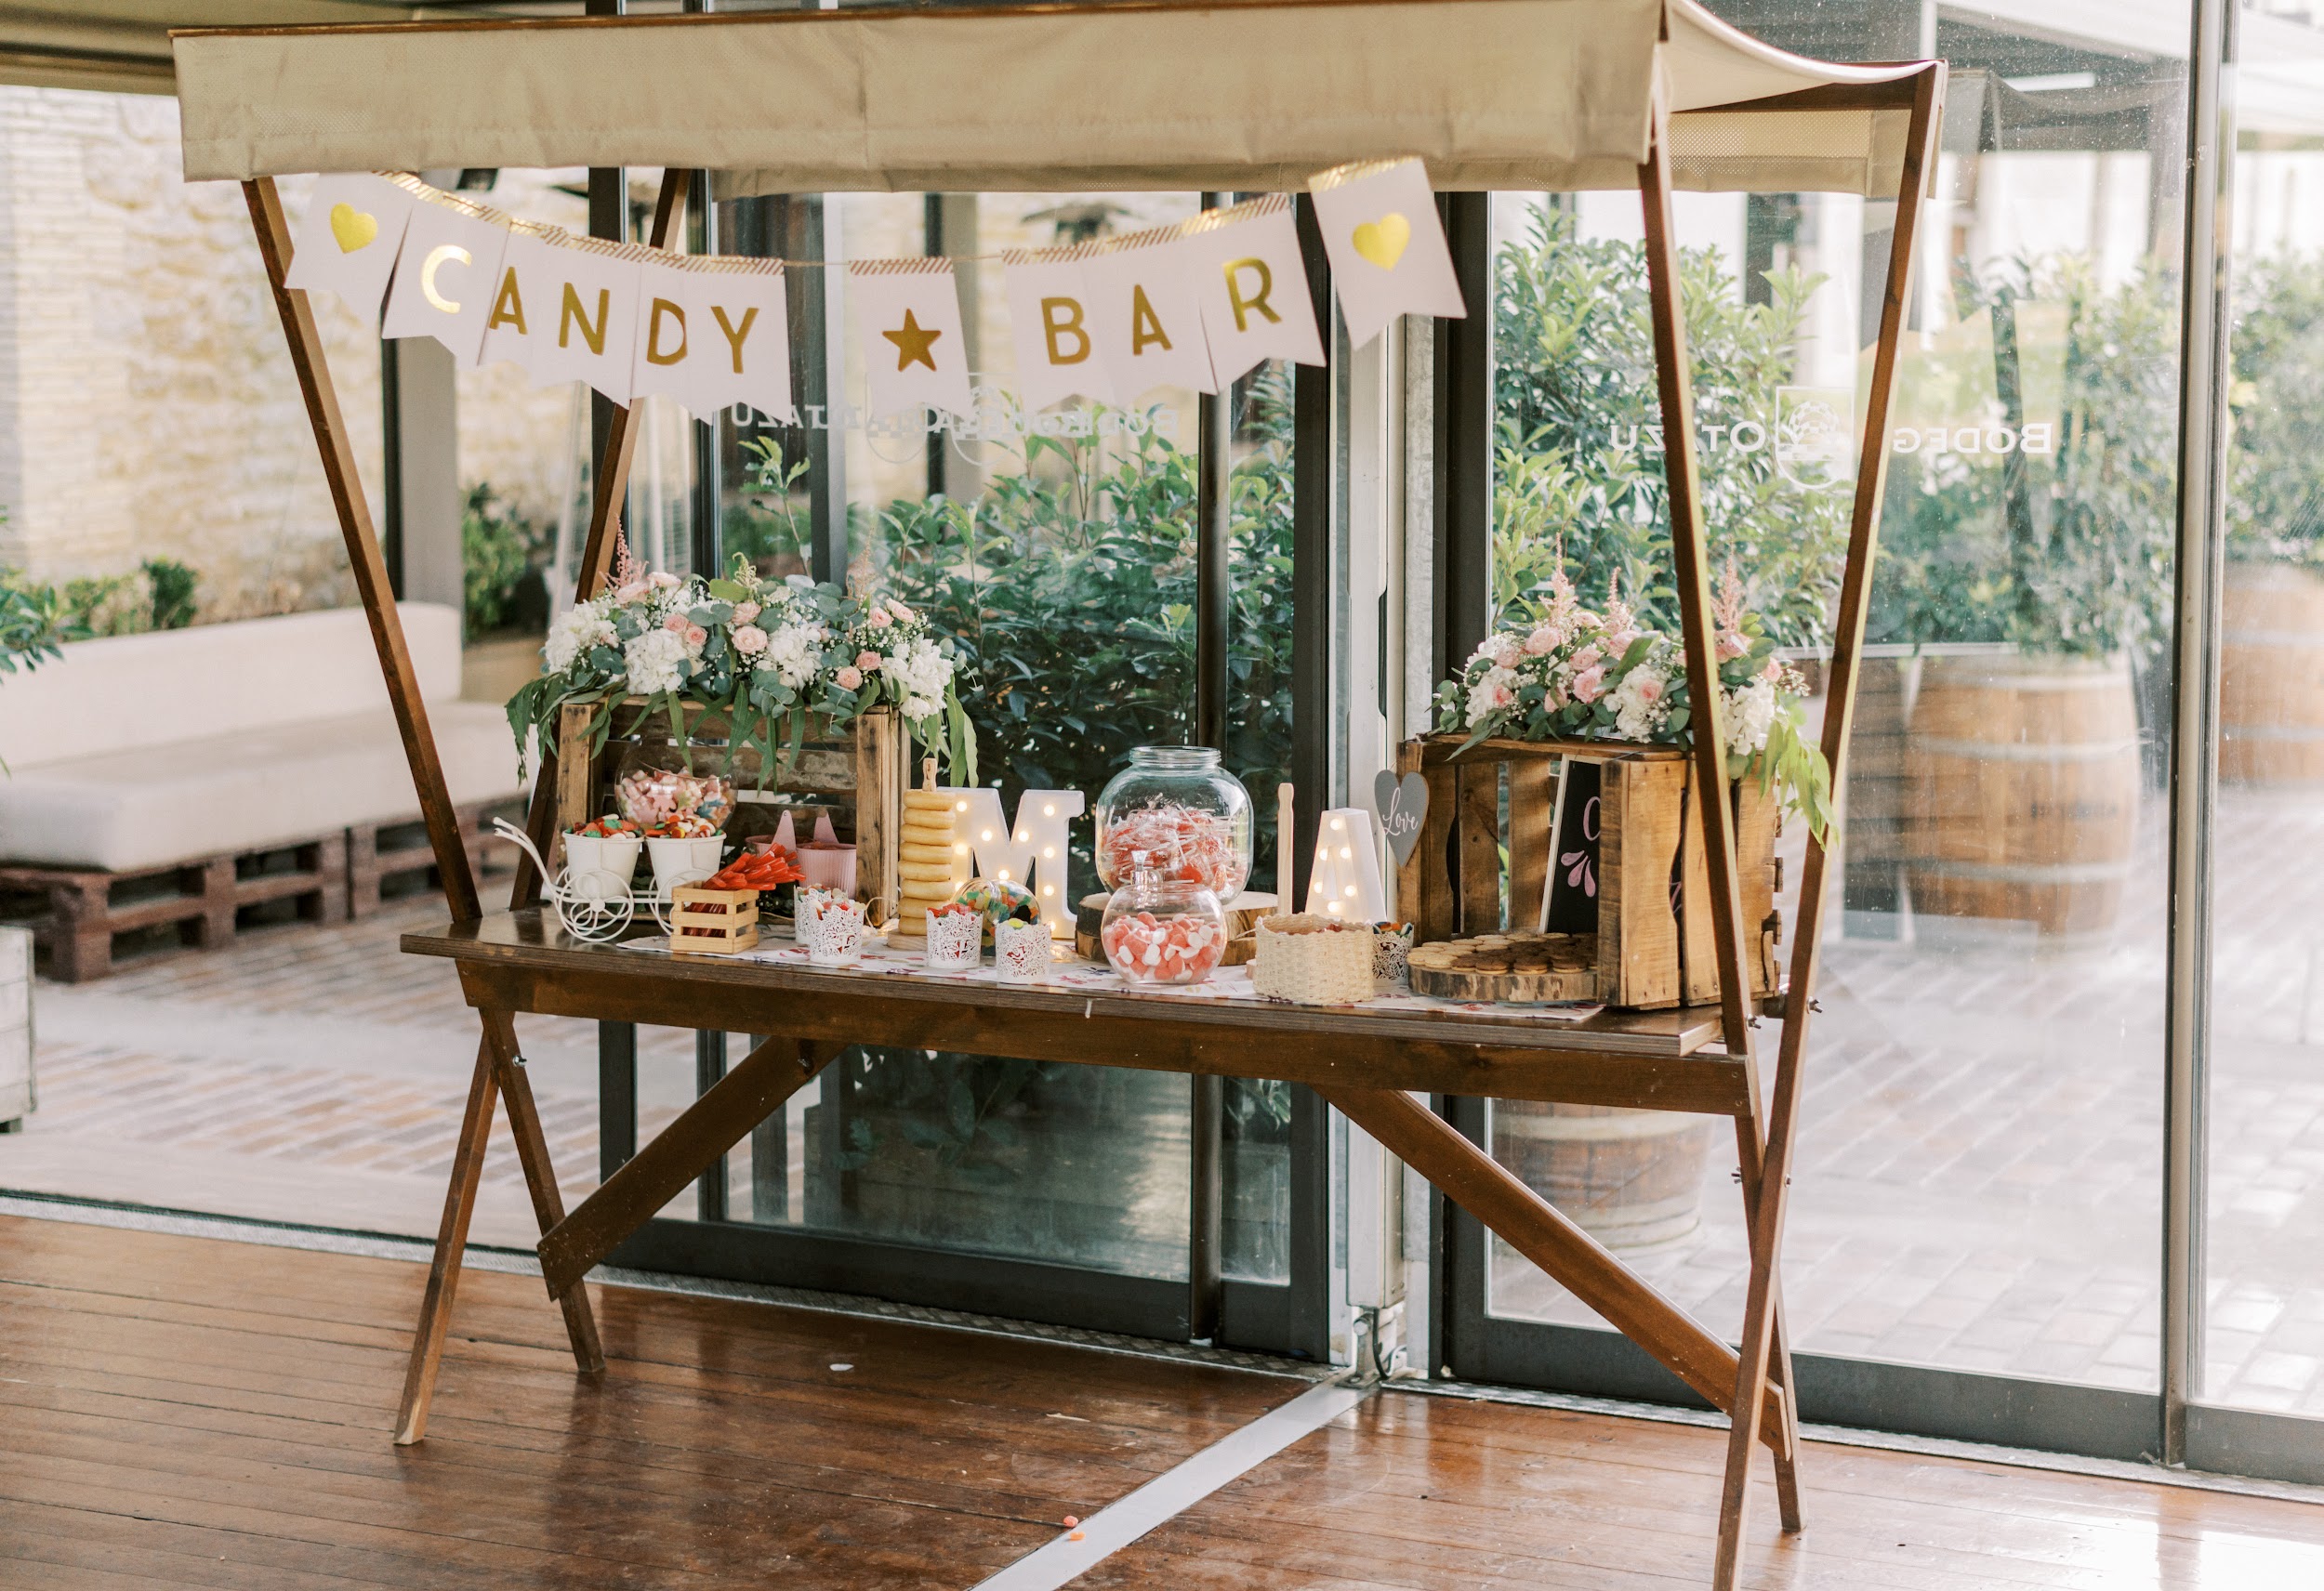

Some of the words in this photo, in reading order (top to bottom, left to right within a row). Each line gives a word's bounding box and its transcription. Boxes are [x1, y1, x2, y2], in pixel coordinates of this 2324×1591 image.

[421, 244, 759, 374] CANDY
[1040, 256, 1282, 365] BAR
[1382, 787, 1419, 835] Love
